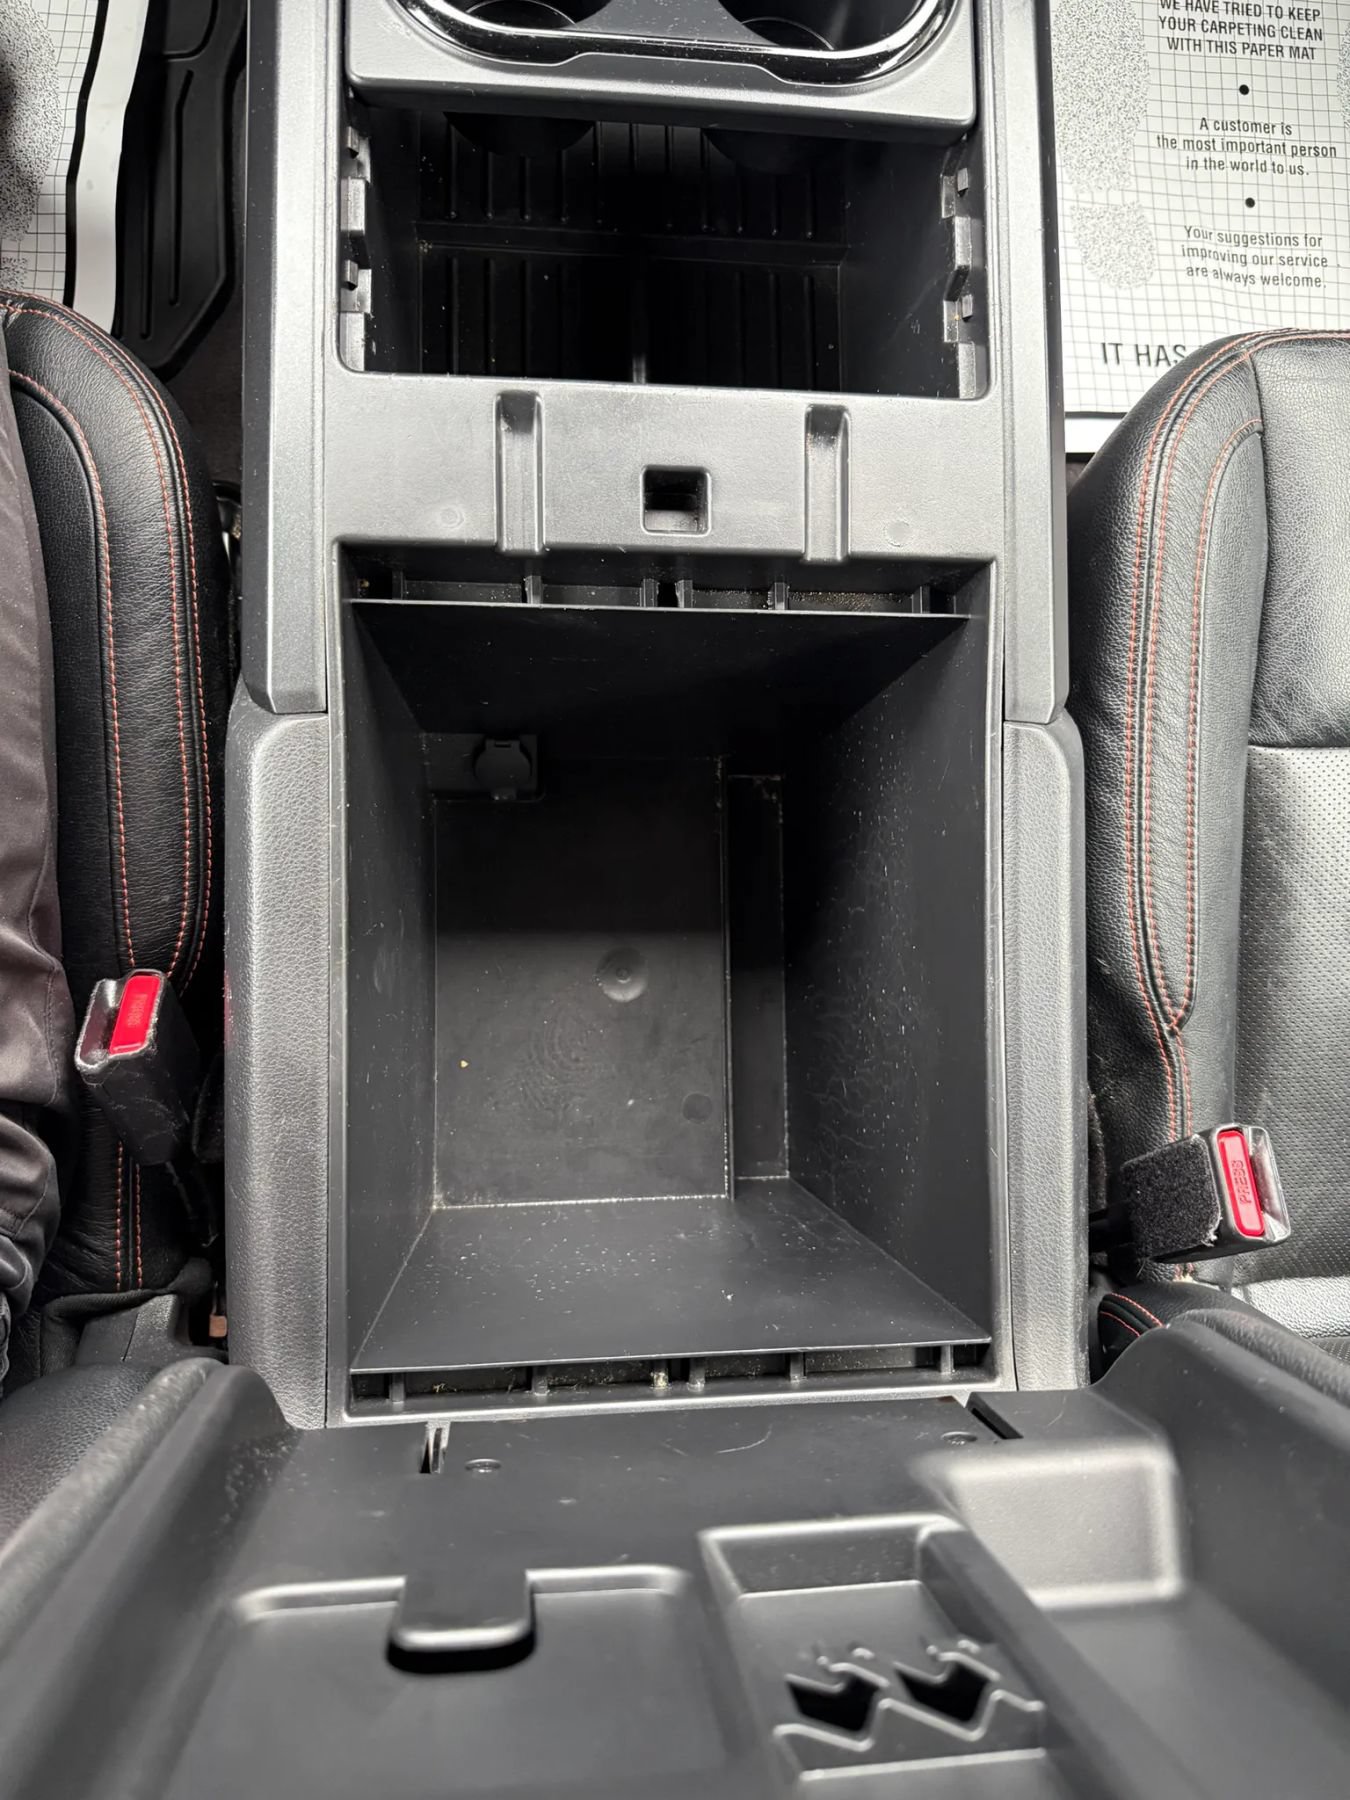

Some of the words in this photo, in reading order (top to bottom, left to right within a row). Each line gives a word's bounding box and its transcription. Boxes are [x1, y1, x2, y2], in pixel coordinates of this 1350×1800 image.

[1160, 0, 1180, 10] WE
[1185, 0, 1219, 13] HAVE
[1223, 1, 1262, 17] TRIED
[1266, 5, 1283, 19] TO
[1288, 7, 1321, 22] KEEP
[1159, 15, 1196, 32] YOUR
[1201, 19, 1276, 38] CARPETING
[1281, 25, 1323, 41] CLEAN
[1167, 36, 1202, 52] WITH
[1206, 40, 1237, 54] THIS
[1242, 42, 1284, 58] PAPER
[1289, 46, 1316, 60] MAT
[1199, 117, 1209, 130] A
[1213, 120, 1276, 134] customer
[1281, 121, 1292, 136] is
[1156, 135, 1177, 149] the
[1182, 138, 1216, 151] most
[1221, 138, 1286, 155] important
[1291, 144, 1337, 158] person
[1186, 156, 1199, 170] in
[1203, 157, 1225, 171] the
[1230, 159, 1267, 173] world
[1272, 161, 1284, 174] to
[1289, 165, 1309, 175] us.
[1184, 225, 1213, 240] Your
[1217, 232, 1300, 248] suggestions
[1304, 233, 1323, 247] for
[1181, 244, 1248, 267] improving
[1252, 254, 1274, 266] our
[1279, 253, 1328, 268] service
[1186, 266, 1208, 277] are
[1212, 267, 1256, 287] always
[1260, 273, 1327, 289] welcome.
[1101, 342, 1123, 365] IT
[1135, 344, 1187, 366] HAS
